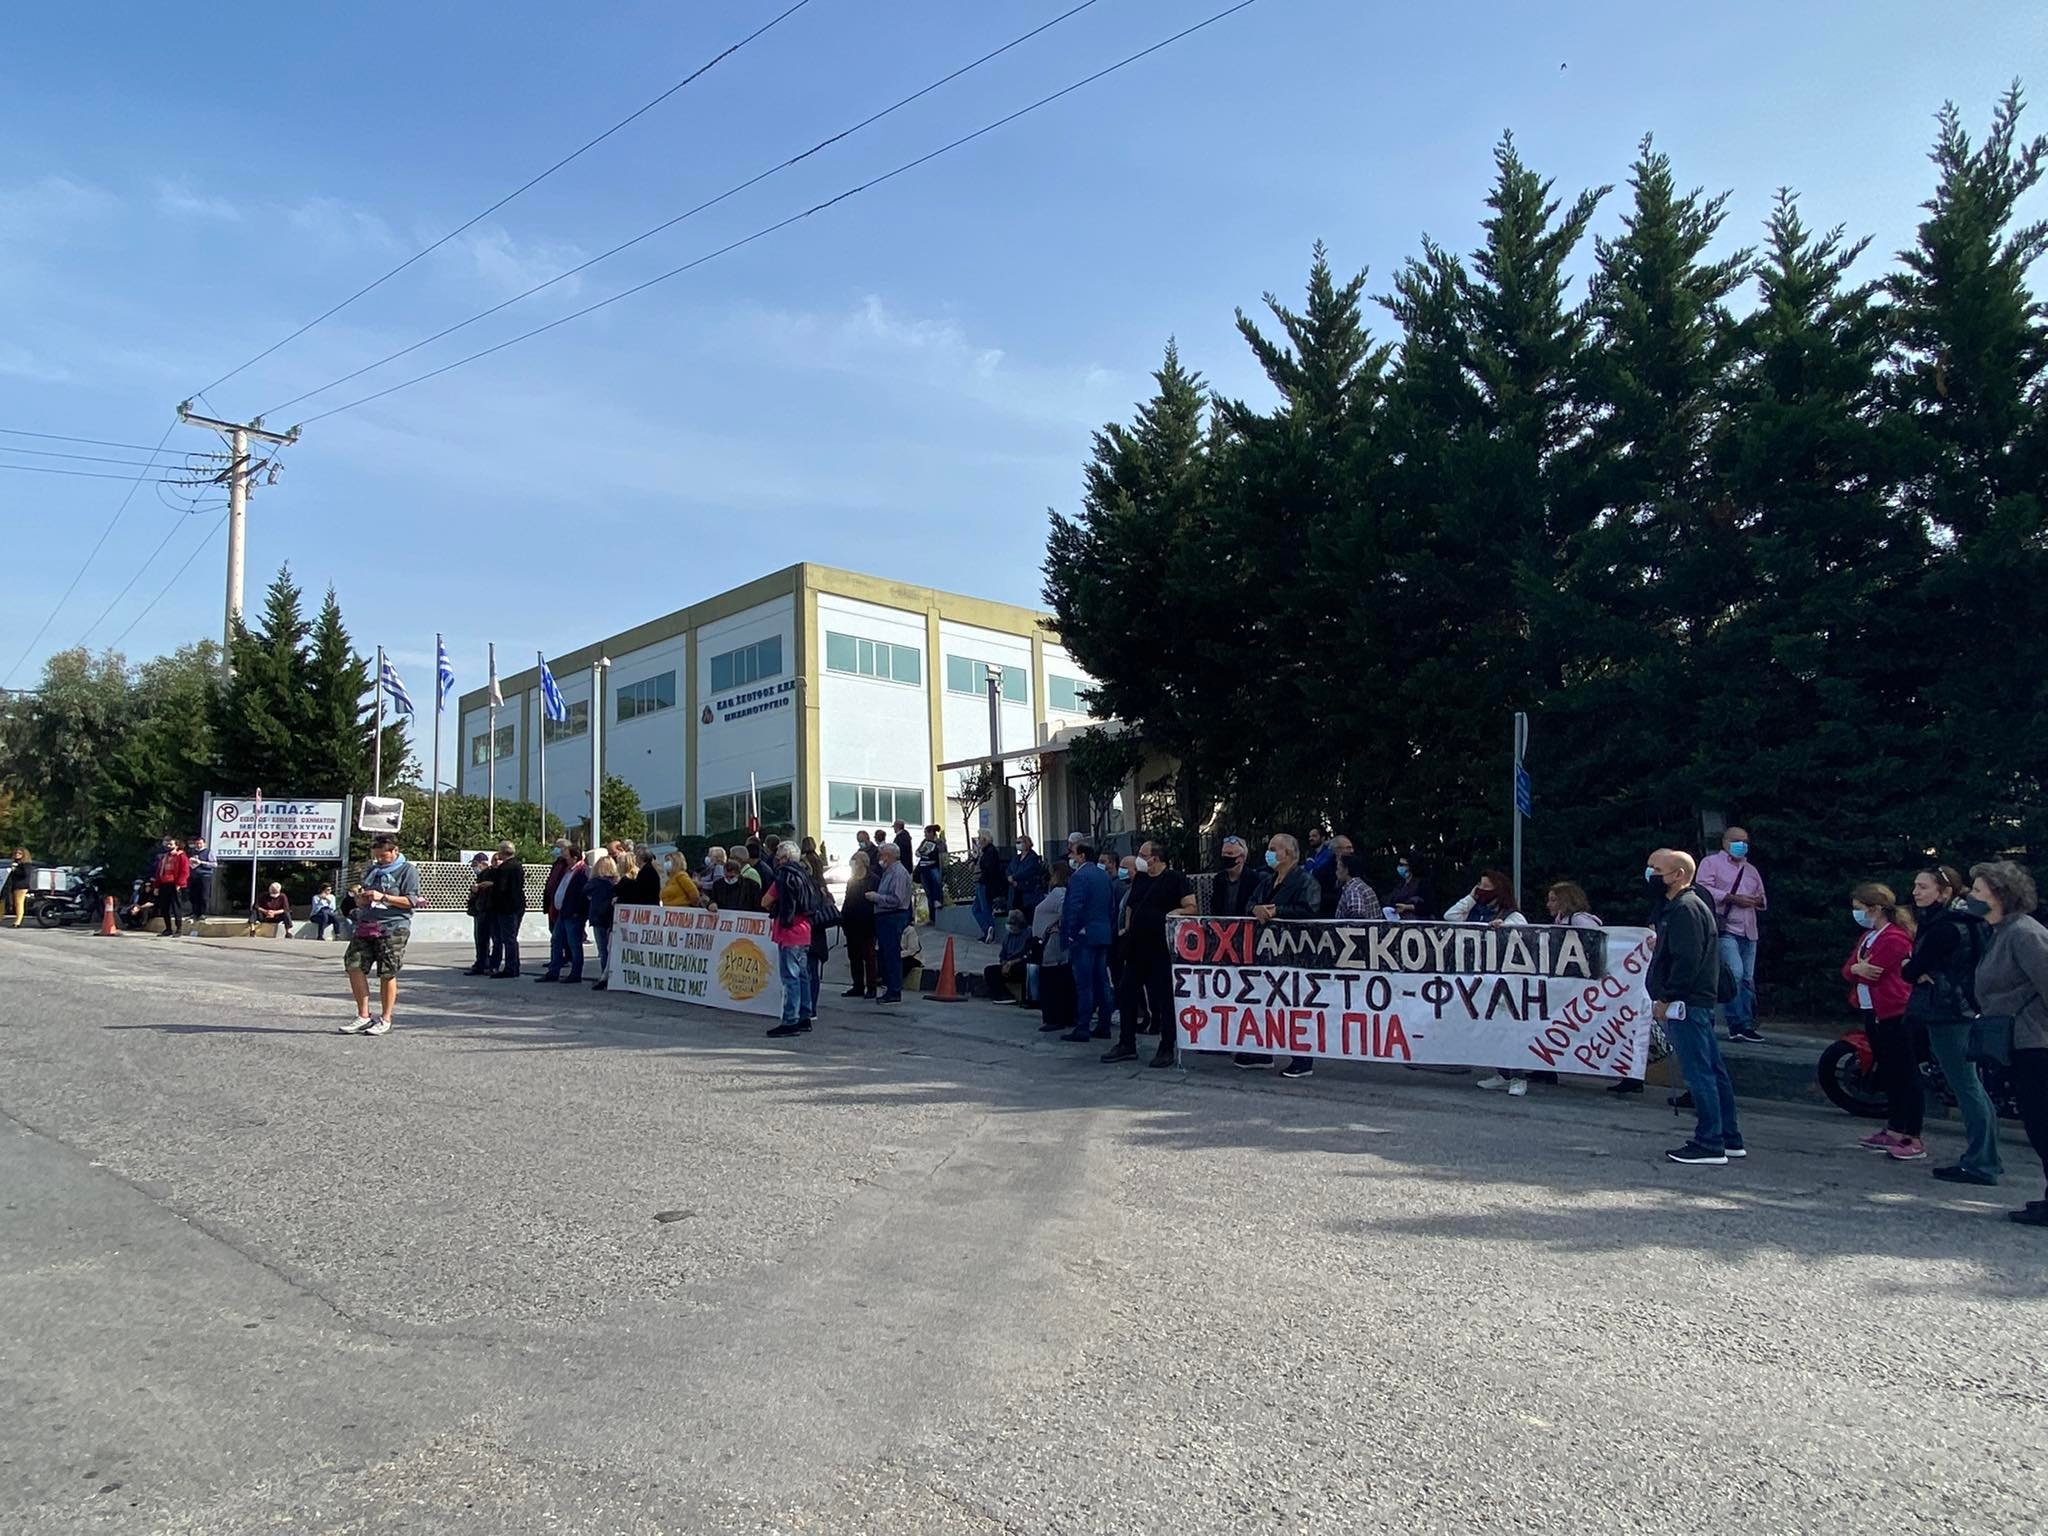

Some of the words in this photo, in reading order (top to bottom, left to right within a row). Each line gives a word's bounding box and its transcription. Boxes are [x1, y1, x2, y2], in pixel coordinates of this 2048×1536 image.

[239, 840, 248, 849] Η
[723, 951, 760, 976] ΣΥΡΙΖΑ
[1175, 919, 1256, 964] ΟΧΙ
[1256, 927, 1337, 957] ΑΛΛΑ
[1335, 926, 1592, 979] ΣΚΟΥΠΙΔΙΑ
[1179, 1005, 1326, 1053] ΦΤΑΝΕΙ
